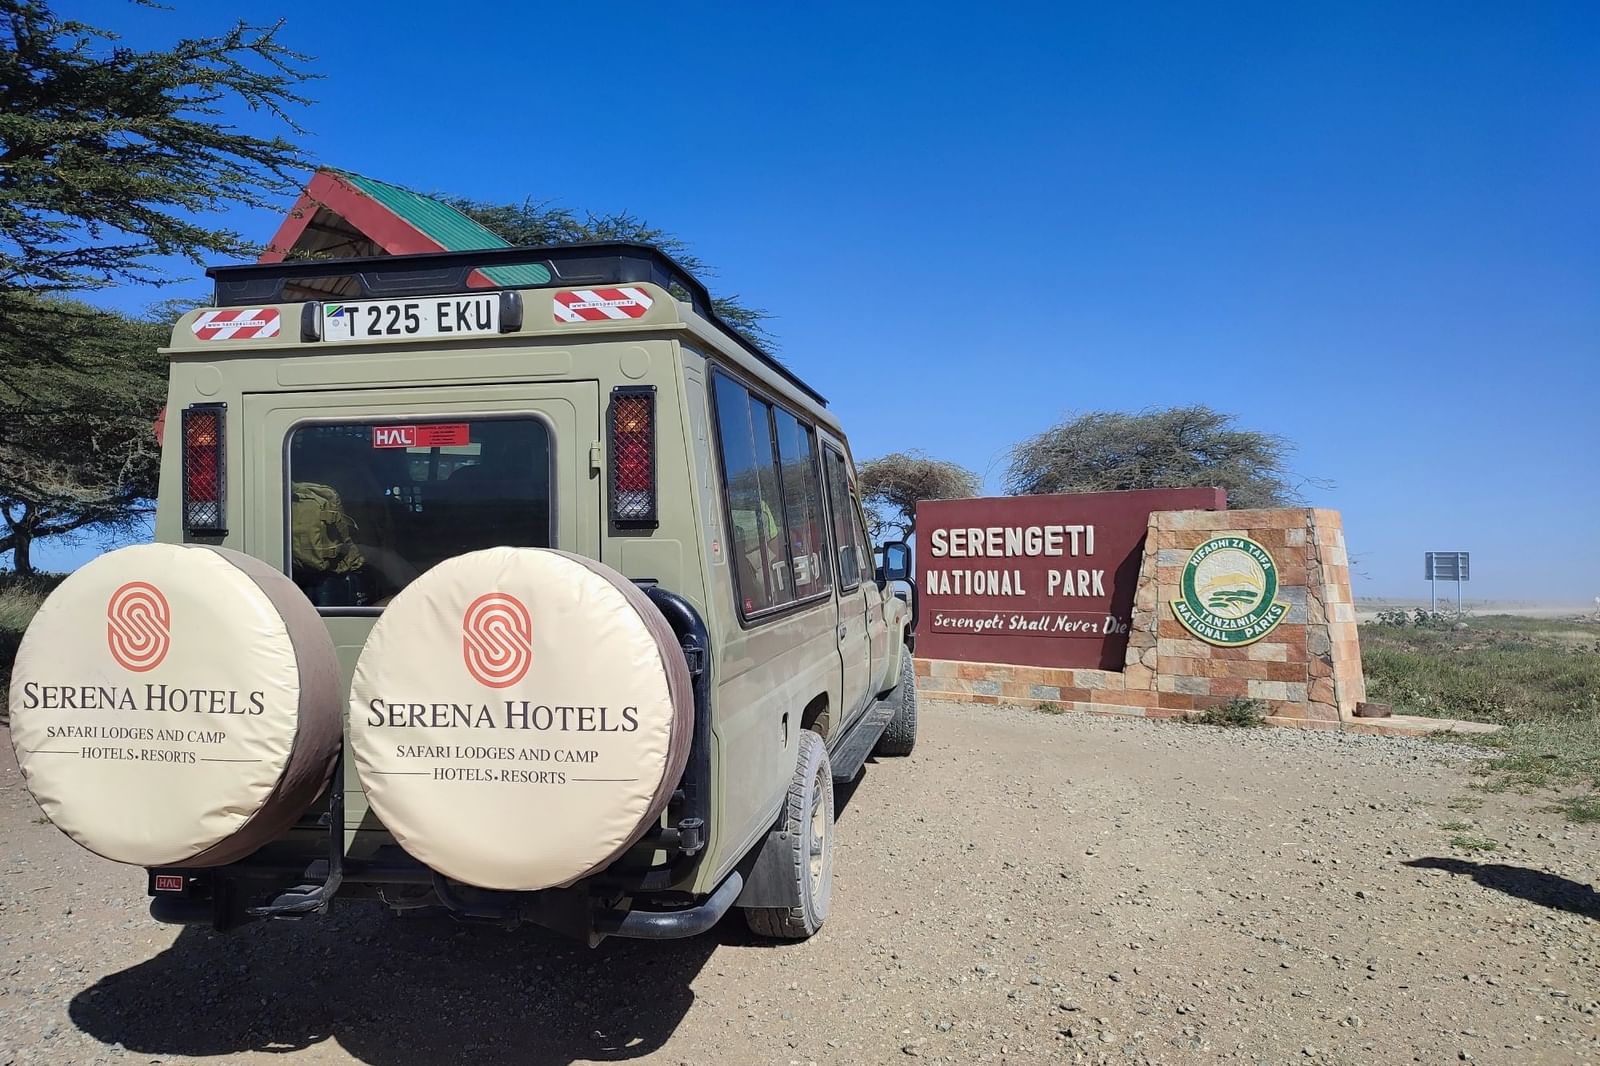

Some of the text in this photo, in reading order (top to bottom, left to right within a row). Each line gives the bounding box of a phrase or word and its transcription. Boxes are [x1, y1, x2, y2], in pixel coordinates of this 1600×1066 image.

[345, 300, 492, 336] T 225 EKU
[376, 429, 412, 445] HAL
[931, 525, 1095, 557] SERENGETI
[1189, 539, 1271, 570] HIFADHI ZA TAIFA
[926, 570, 1105, 597] NATIONAL PARK
[1008, 614, 1050, 632] Shall
[1051, 615, 1098, 633] Never
[1102, 615, 1128, 635] Die
[1177, 603, 1282, 641] NATIONAL PARKS
[1199, 608, 1258, 629] TANZANIA
[23, 682, 265, 715] SERENA HOTELS
[367, 698, 639, 732] SERENA HOTELS
[46, 726, 226, 744] SAFARI LODGES AND CAMP
[396, 745, 599, 763] SAFARI LODGES AND CAMP
